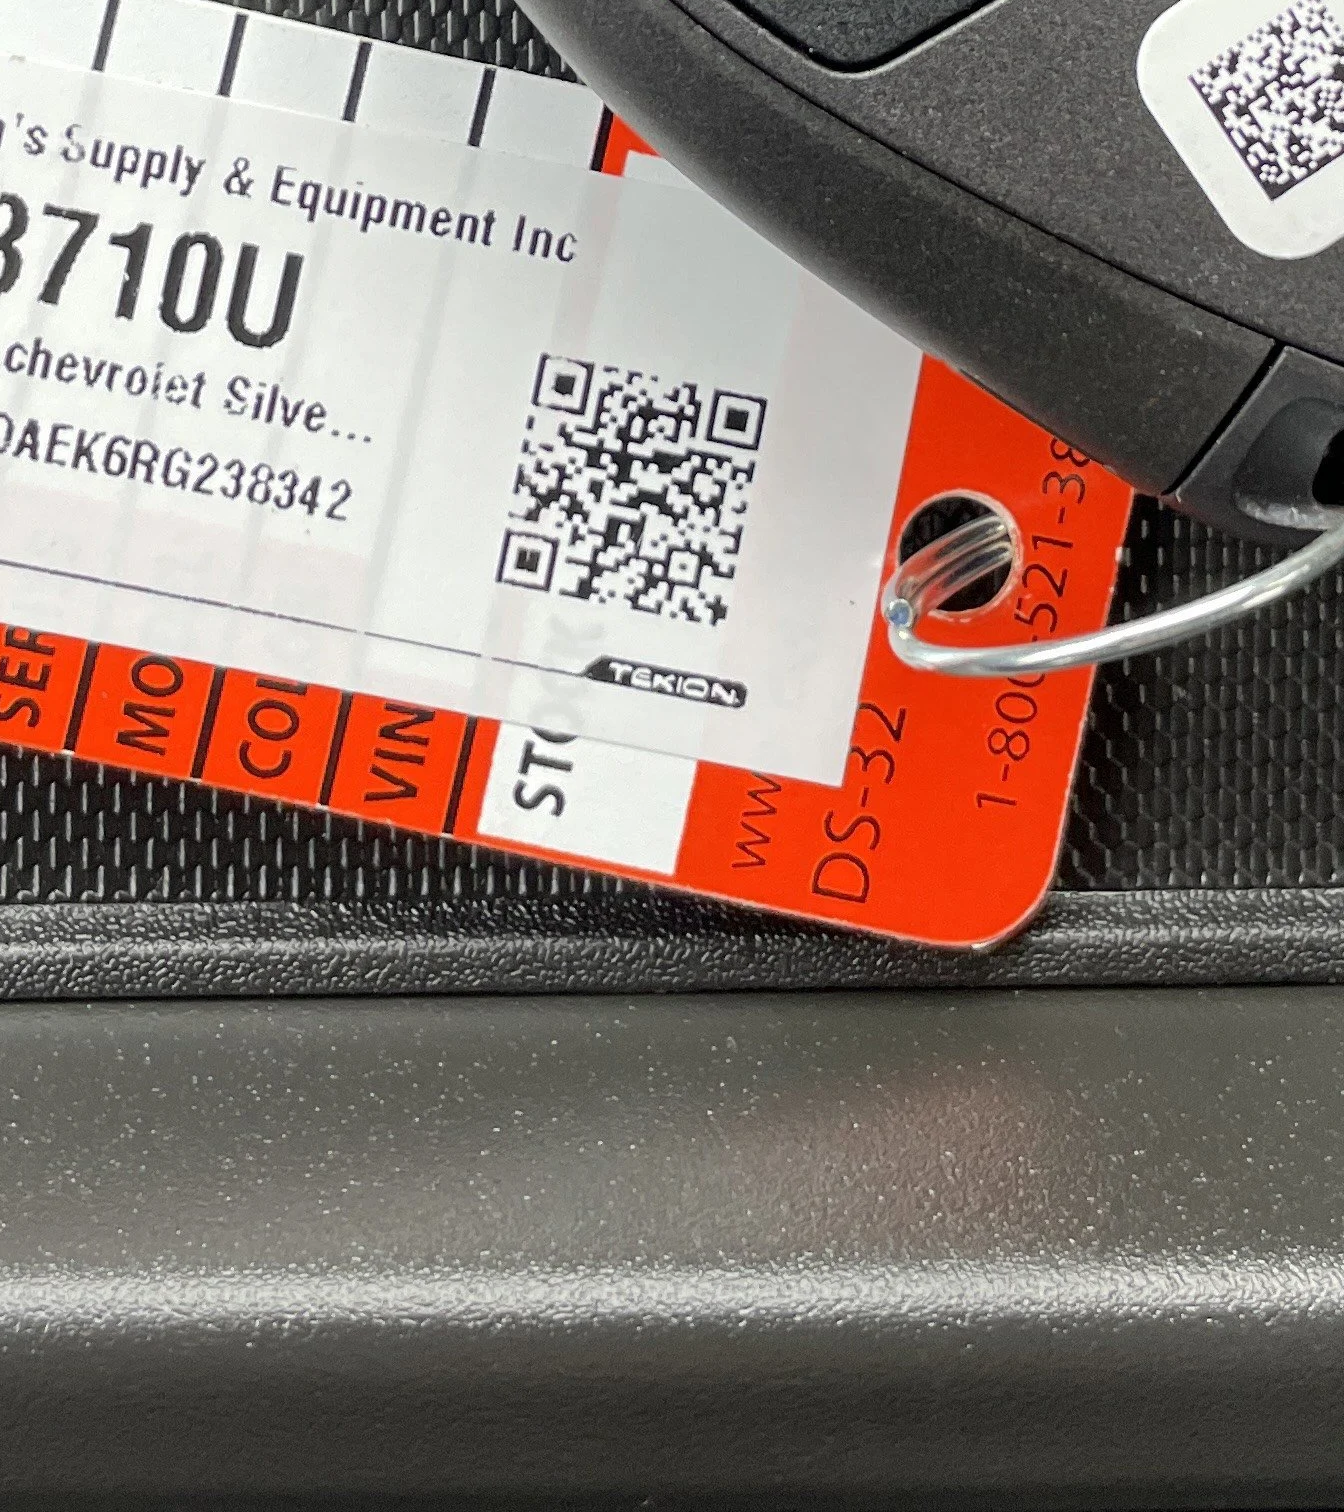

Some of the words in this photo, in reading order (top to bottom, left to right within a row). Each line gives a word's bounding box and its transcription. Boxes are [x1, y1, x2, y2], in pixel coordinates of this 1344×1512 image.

[60, 124, 206, 198] Supply
[223, 157, 255, 199] &
[270, 165, 497, 248] Equipment
[511, 214, 579, 264] Inc
[222, 375, 373, 445] Silve...
[115, 653, 185, 757] MO
[363, 701, 436, 803] VIN
[811, 702, 908, 904] DS-32
